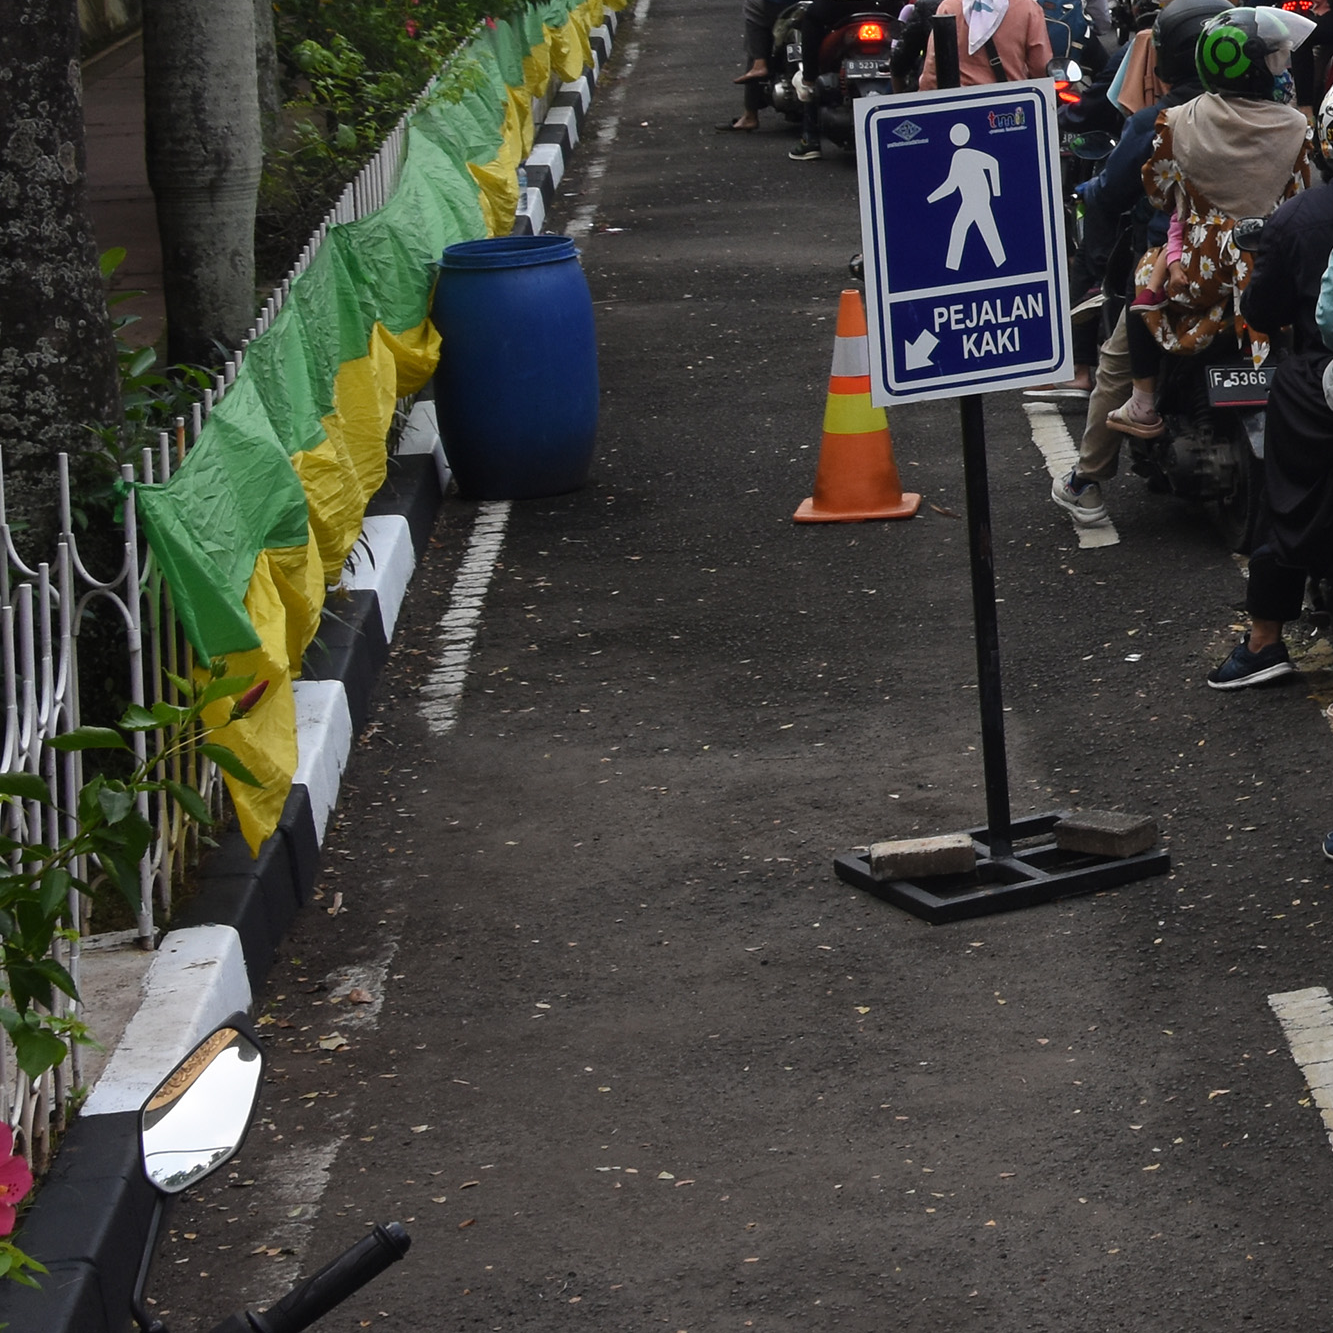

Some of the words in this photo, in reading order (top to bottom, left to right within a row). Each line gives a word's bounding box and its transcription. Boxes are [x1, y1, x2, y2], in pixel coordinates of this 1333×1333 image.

[848, 61, 855, 70] B
[933, 292, 1044, 333] PEJALAN
[962, 326, 1021, 359] KAKI
[1214, 372, 1222, 386] F
[1230, 371, 1267, 385] 5366
